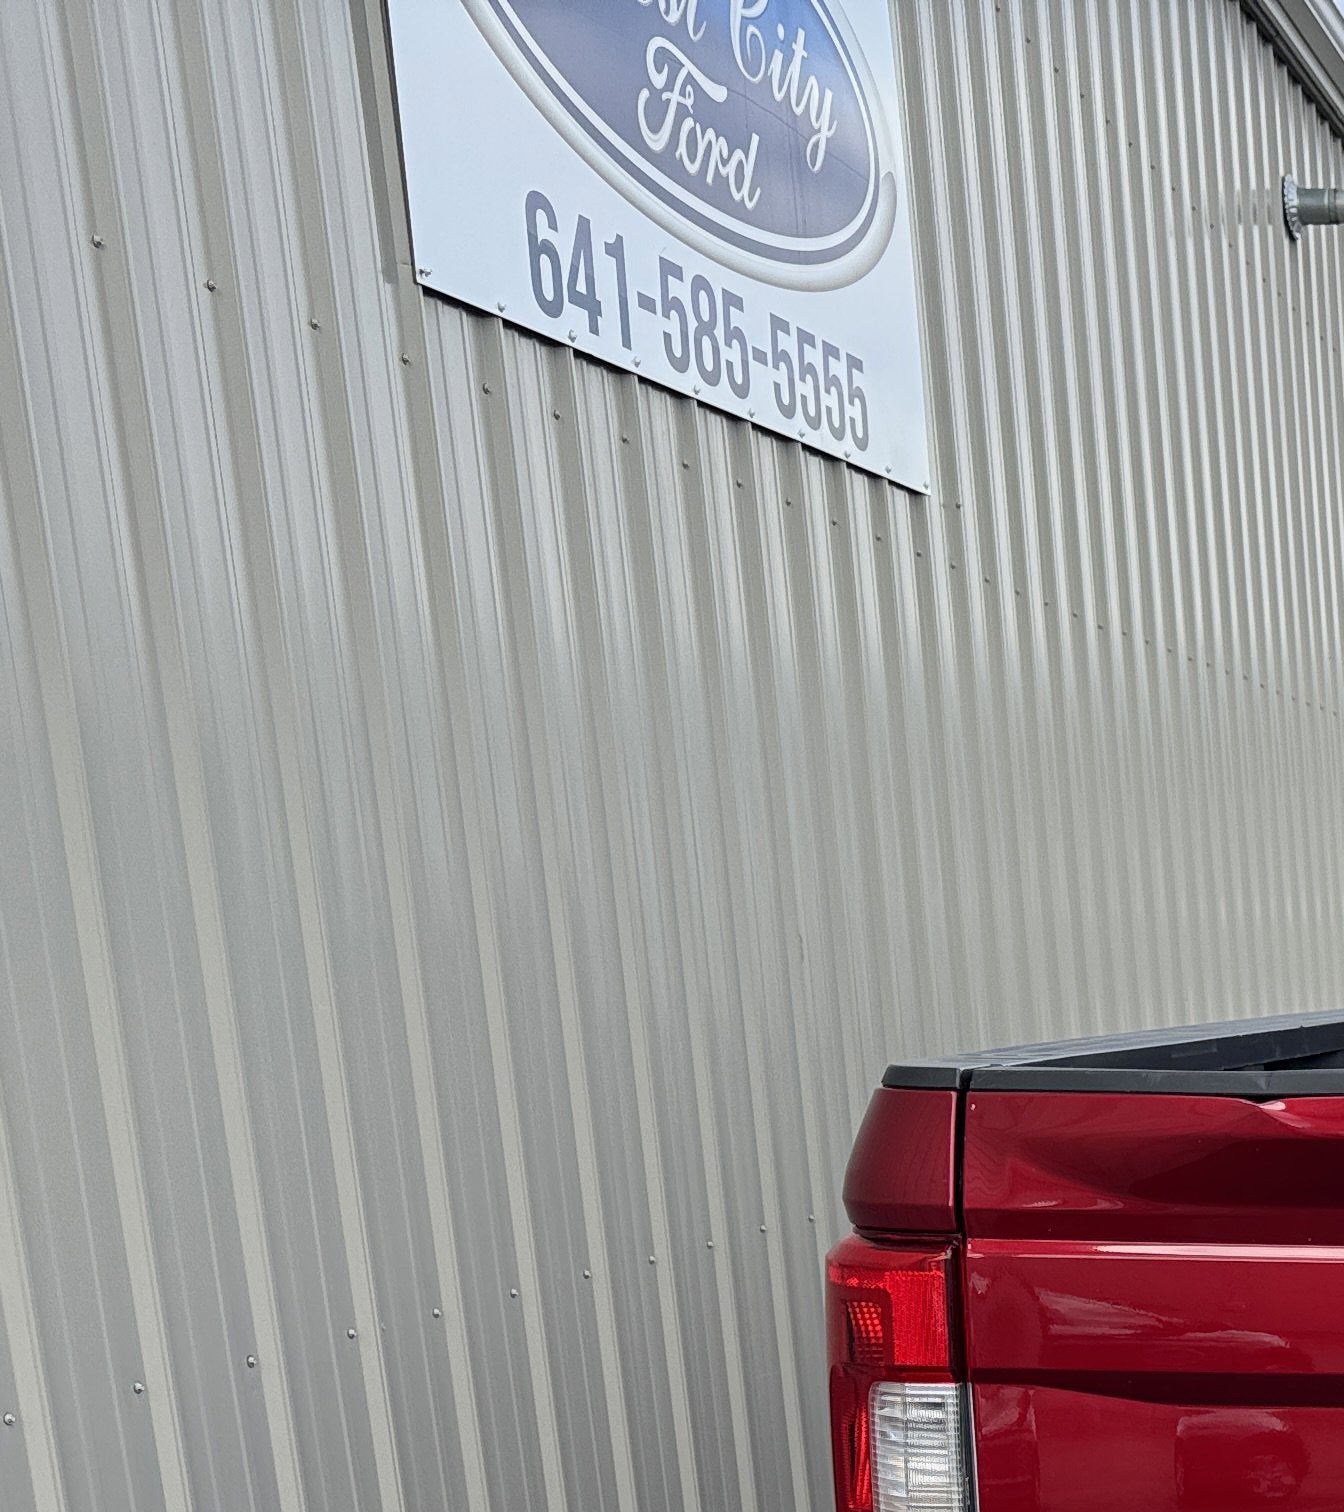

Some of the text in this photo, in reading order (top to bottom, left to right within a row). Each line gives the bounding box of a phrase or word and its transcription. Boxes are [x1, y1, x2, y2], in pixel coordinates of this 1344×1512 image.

[637, 36, 761, 210] Ford
[729, 0, 838, 174] City
[525, 189, 869, 452] 641-585-5555
